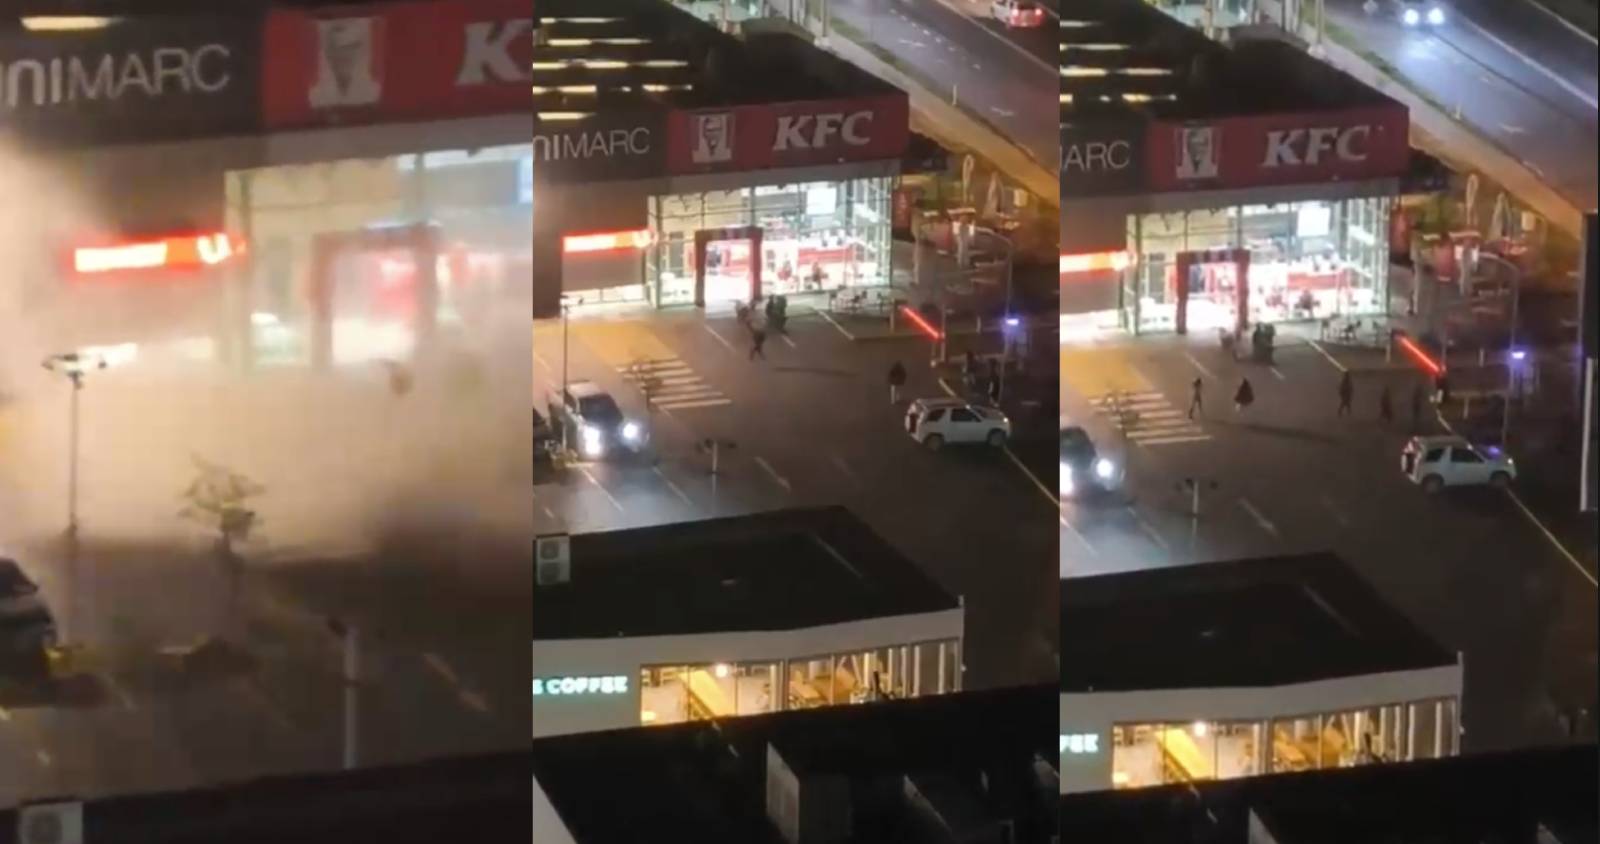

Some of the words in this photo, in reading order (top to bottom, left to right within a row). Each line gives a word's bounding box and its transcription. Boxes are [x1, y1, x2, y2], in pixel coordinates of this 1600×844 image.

[772, 107, 875, 151] KFC
[1261, 124, 1371, 168] KFC
[1060, 140, 1130, 171] ARC
[546, 675, 629, 695] COFFEE
